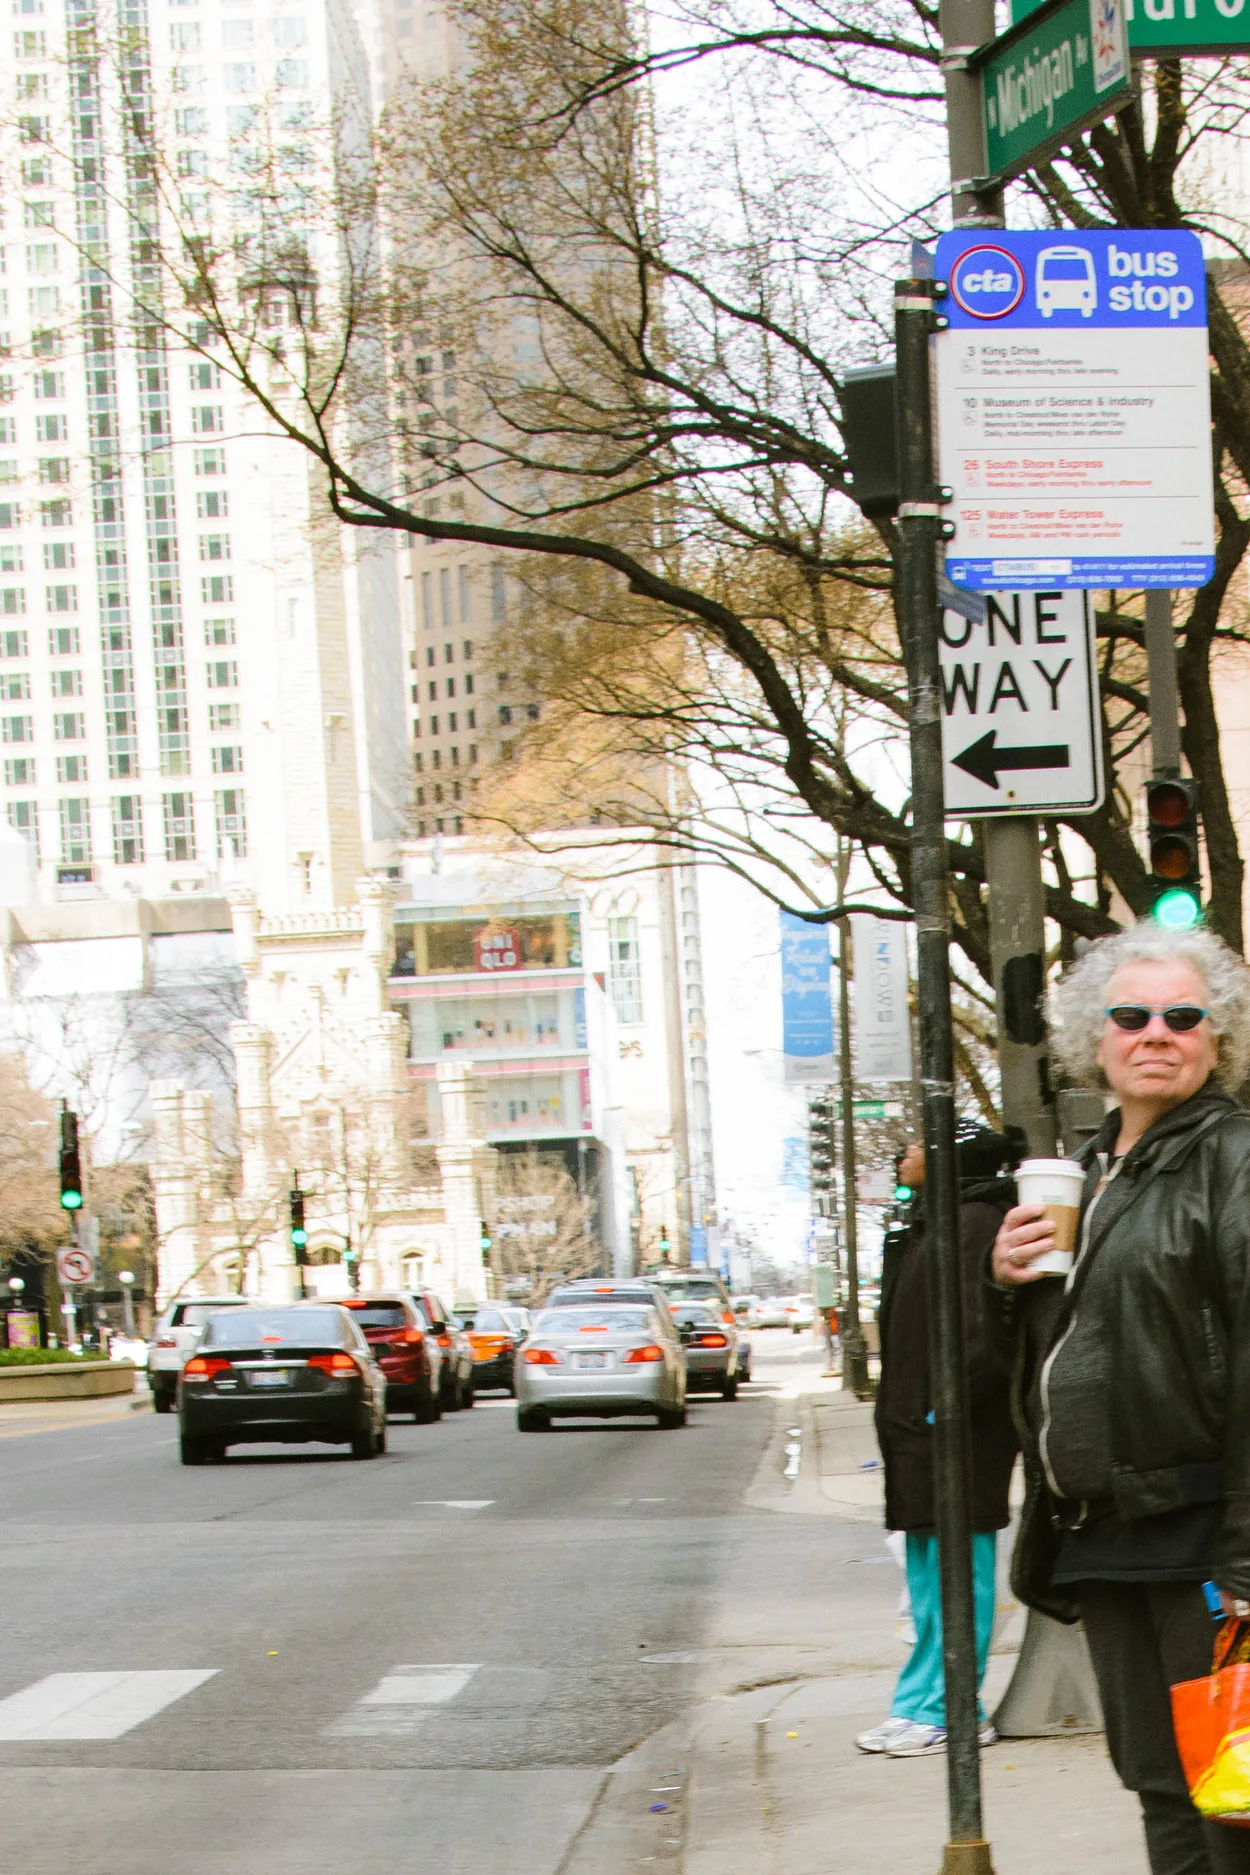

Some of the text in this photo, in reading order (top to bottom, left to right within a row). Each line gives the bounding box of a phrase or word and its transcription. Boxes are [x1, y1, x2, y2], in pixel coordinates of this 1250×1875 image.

[997, 40, 1074, 138] Michigan
[1108, 245, 1179, 277] bus
[962, 269, 1013, 293] cta
[1108, 281, 1194, 320] stop
[967, 345, 1041, 358] 3 King Drive
[964, 397, 977, 409] 10
[982, 398, 1031, 407] Museum
[1035, 398, 1045, 407] of
[1049, 397, 1093, 406] Science
[1109, 397, 1155, 407] Industry
[985, 460, 1018, 469] South
[1022, 459, 1055, 469] Shore
[1058, 459, 1104, 468] Express
[987, 511, 1018, 519] Water
[1022, 510, 1054, 519] Tower
[1059, 510, 1105, 519] Express
[940, 591, 1067, 648] ONE
[940, 658, 1073, 716] WAY
[481, 951, 517, 970] QLO
